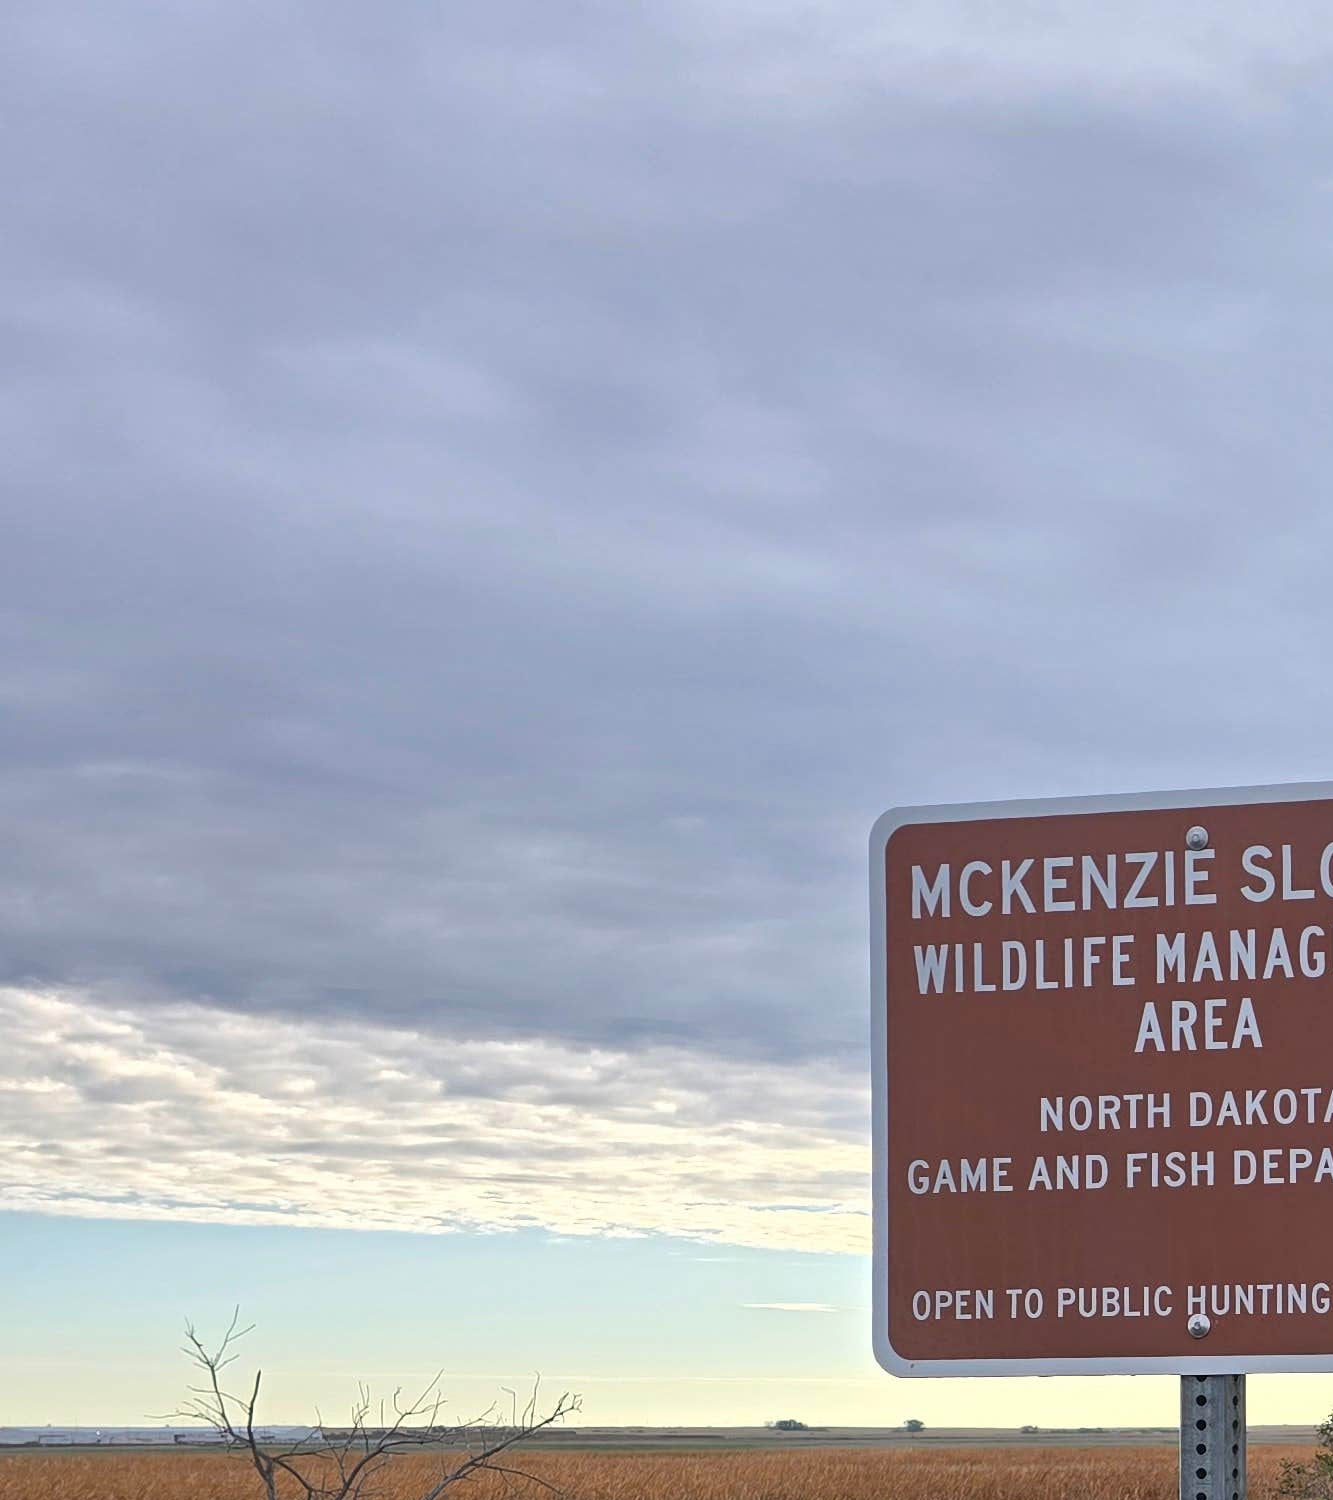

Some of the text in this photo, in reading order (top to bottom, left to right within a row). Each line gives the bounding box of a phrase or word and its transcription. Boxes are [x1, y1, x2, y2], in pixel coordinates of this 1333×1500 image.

[910, 848, 1218, 920] MCKENZIE
[914, 934, 1136, 995] WILDLIFE
[1134, 997, 1263, 1053] AREA
[1040, 1093, 1171, 1132] NORTH
[908, 1157, 1014, 1194] GAME
[1028, 1155, 1109, 1190] AND
[1126, 1150, 1216, 1188] FISH
[912, 1283, 1331, 1321] OPEN TO PUBLIC HUNTING
